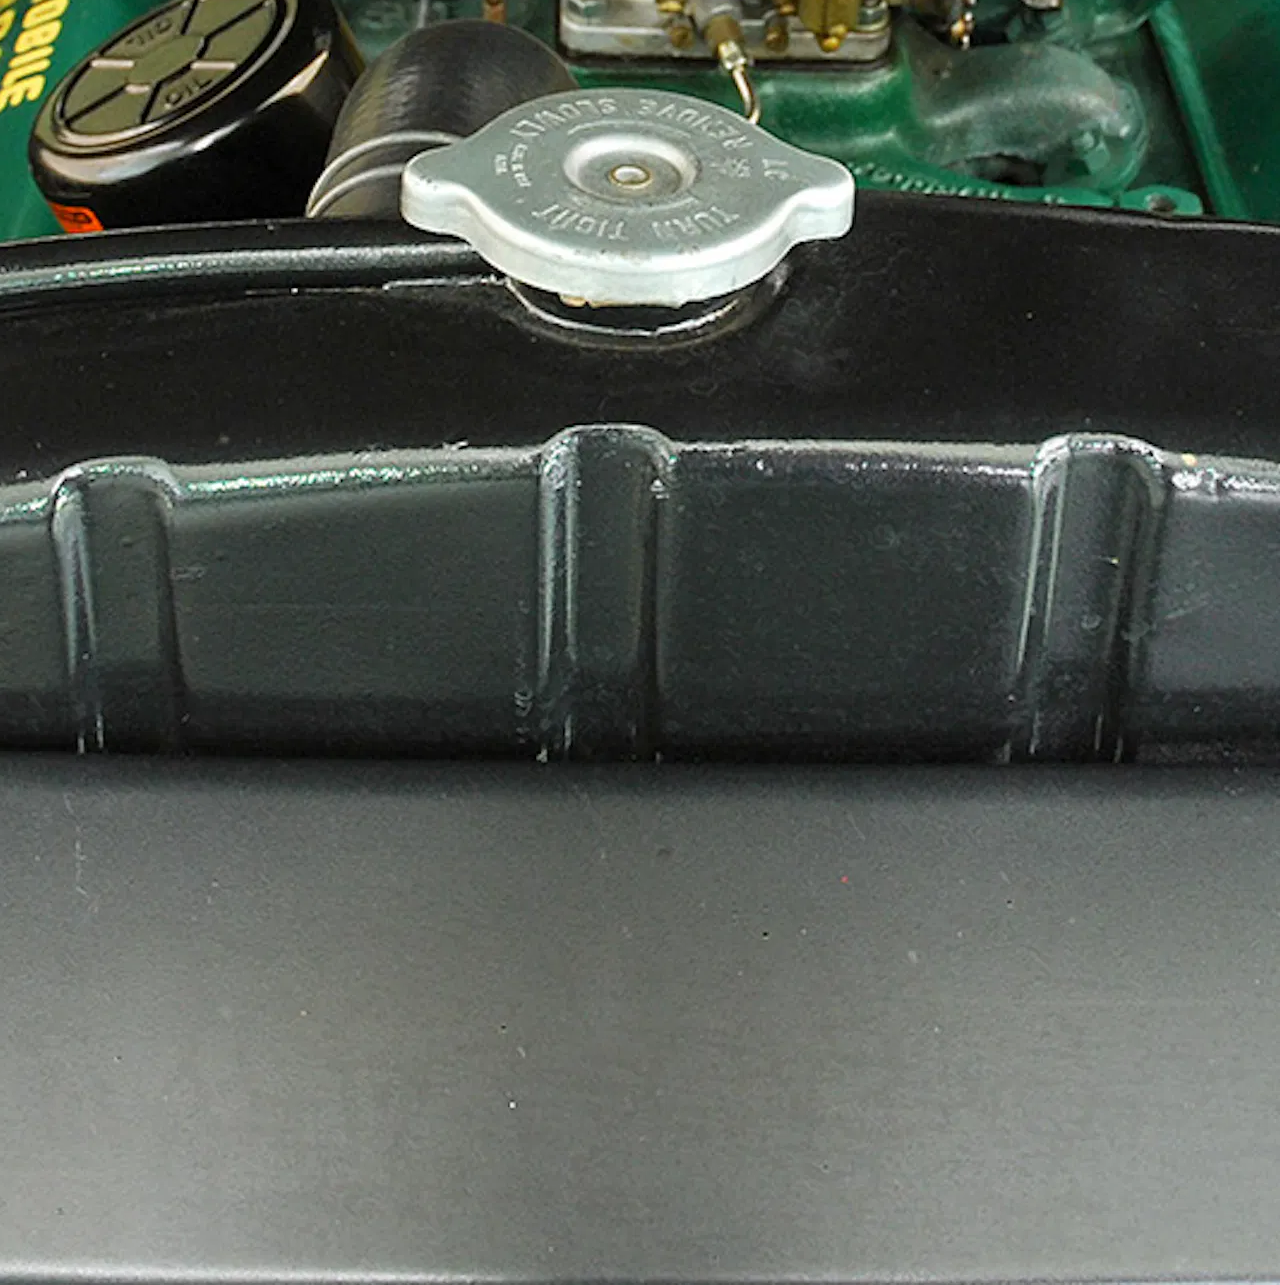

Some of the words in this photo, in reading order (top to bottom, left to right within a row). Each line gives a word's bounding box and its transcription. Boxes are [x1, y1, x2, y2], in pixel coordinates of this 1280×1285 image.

[124, 17, 175, 47] OIL
[165, 77, 213, 106] OIL
[509, 98, 617, 138] SLOWLY
[637, 98, 754, 151] REMOVE
[531, 203, 630, 241] TIGHT
[652, 205, 740, 240] TURN
